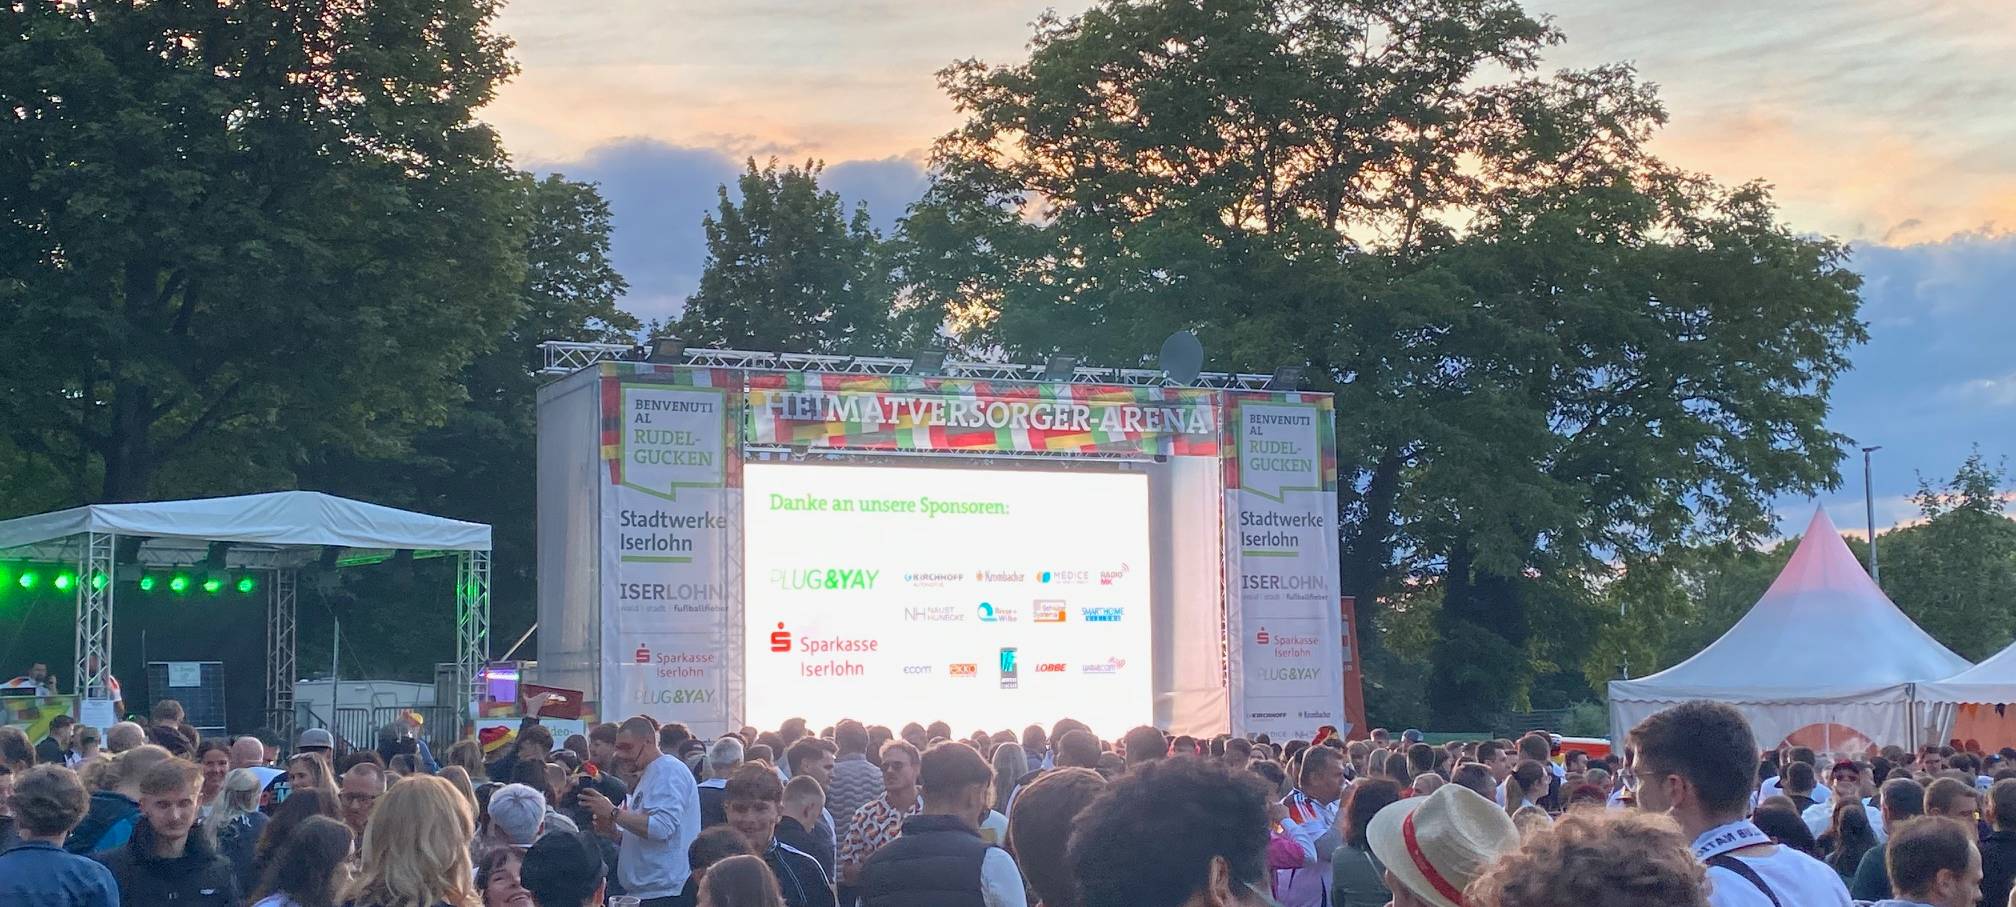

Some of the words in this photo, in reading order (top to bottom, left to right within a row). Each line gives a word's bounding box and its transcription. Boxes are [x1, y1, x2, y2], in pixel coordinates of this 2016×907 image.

[635, 399, 713, 413] BENVENUTI
[765, 391, 1208, 433] HEIMATVERSORGER-ARENA
[635, 413, 652, 424] AL
[1250, 415, 1310, 426] BENVENUTI
[634, 429, 702, 446] RUDEL-
[1250, 426, 1263, 436] AL
[1250, 440, 1302, 455] RUDEL-
[634, 450, 712, 466] GUCKEN
[1250, 458, 1312, 472] GUCKEN
[769, 493, 827, 511] Danke
[832, 497, 854, 512] an
[858, 499, 916, 513] unsere
[920, 496, 1009, 518] Sponsoren:
[620, 510, 727, 529] Stadtwerke
[1240, 511, 1324, 528] Stadtwerke
[620, 533, 692, 551] Iserlohn
[1241, 531, 1299, 548] Iserlohn
[771, 568, 880, 590] PLUG&YAY
[904, 607, 926, 621] NH
[800, 635, 879, 656] Sparkasse
[1274, 635, 1318, 645] Sparkasse
[656, 652, 714, 664] Sparkasse
[1275, 649, 1311, 658] Iserlohn
[656, 667, 704, 678] Iserlohn
[801, 660, 864, 677] Iserlohn
[1035, 663, 1066, 673] LOBBE
[1257, 667, 1321, 681] PLUG&YAY
[635, 689, 715, 705] PLUG&YAY
